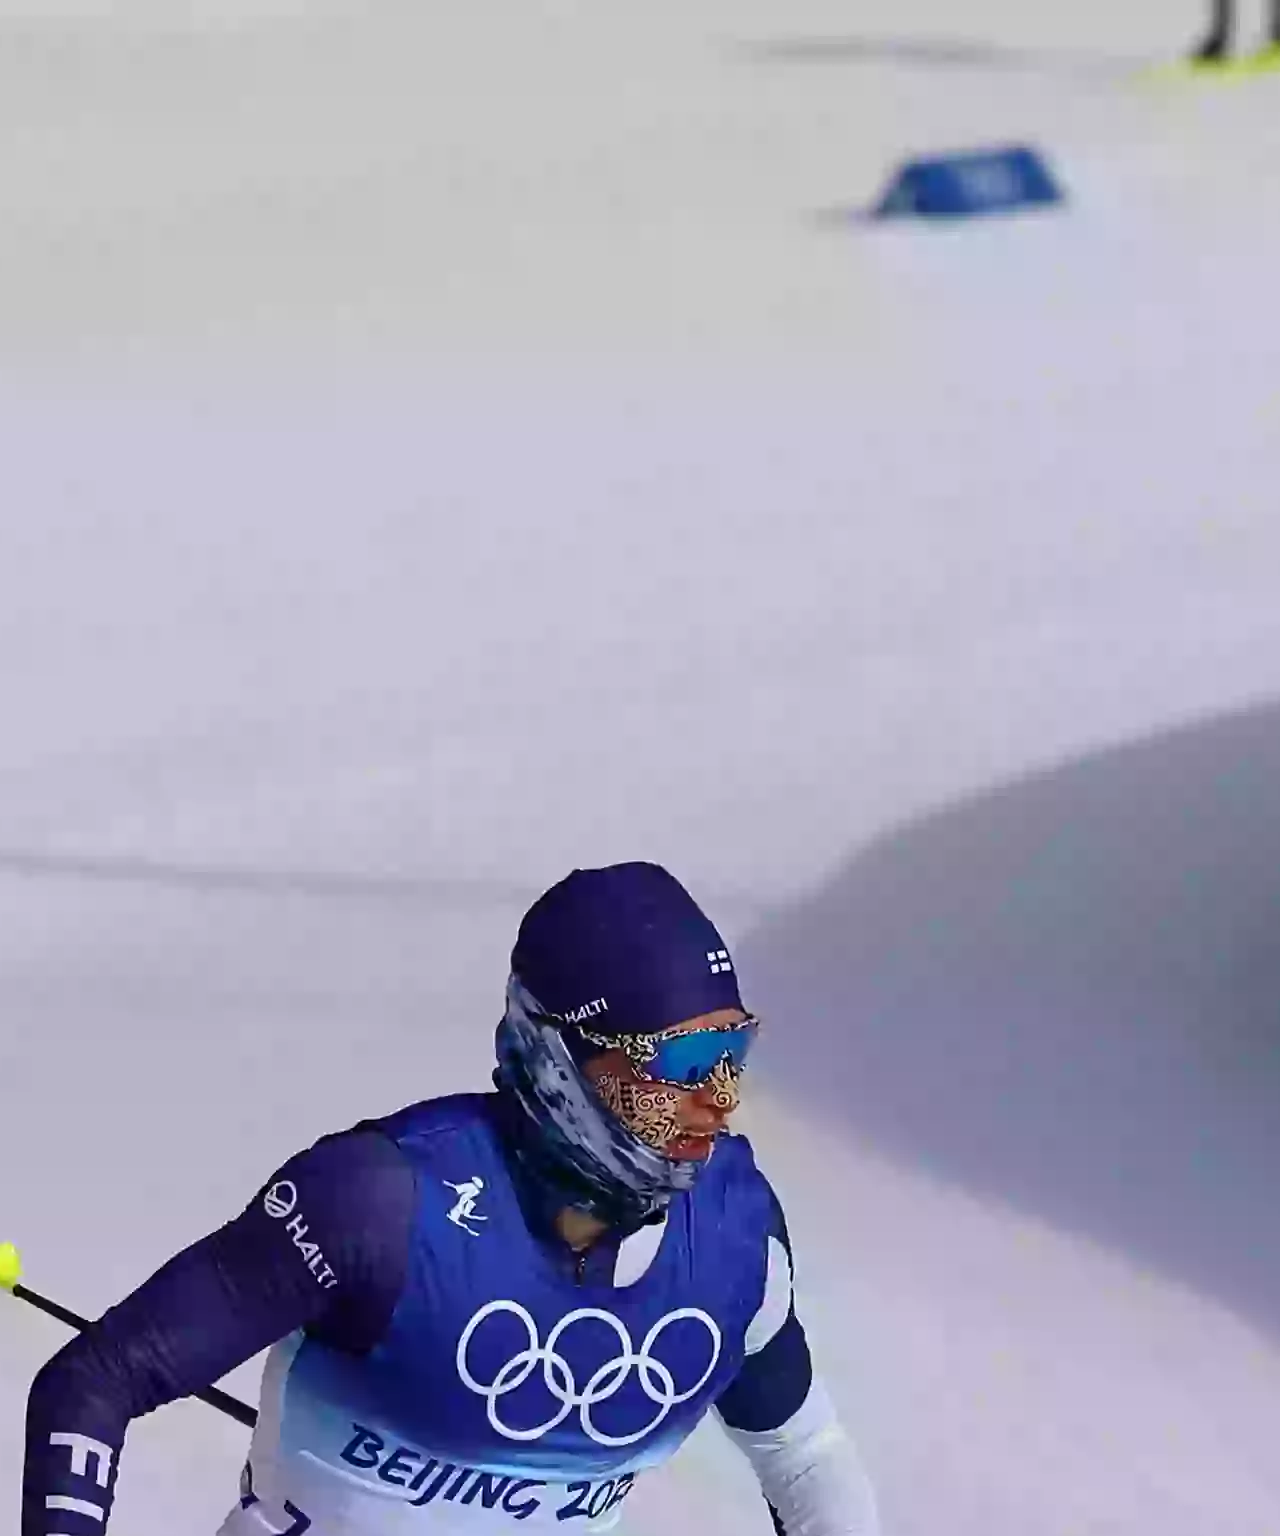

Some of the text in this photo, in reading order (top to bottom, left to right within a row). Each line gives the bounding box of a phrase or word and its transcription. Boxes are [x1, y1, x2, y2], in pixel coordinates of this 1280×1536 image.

[565, 997, 608, 1024] HALTI
[285, 1213, 338, 1288] HALTI
[339, 1421, 547, 1520] BEIJING
